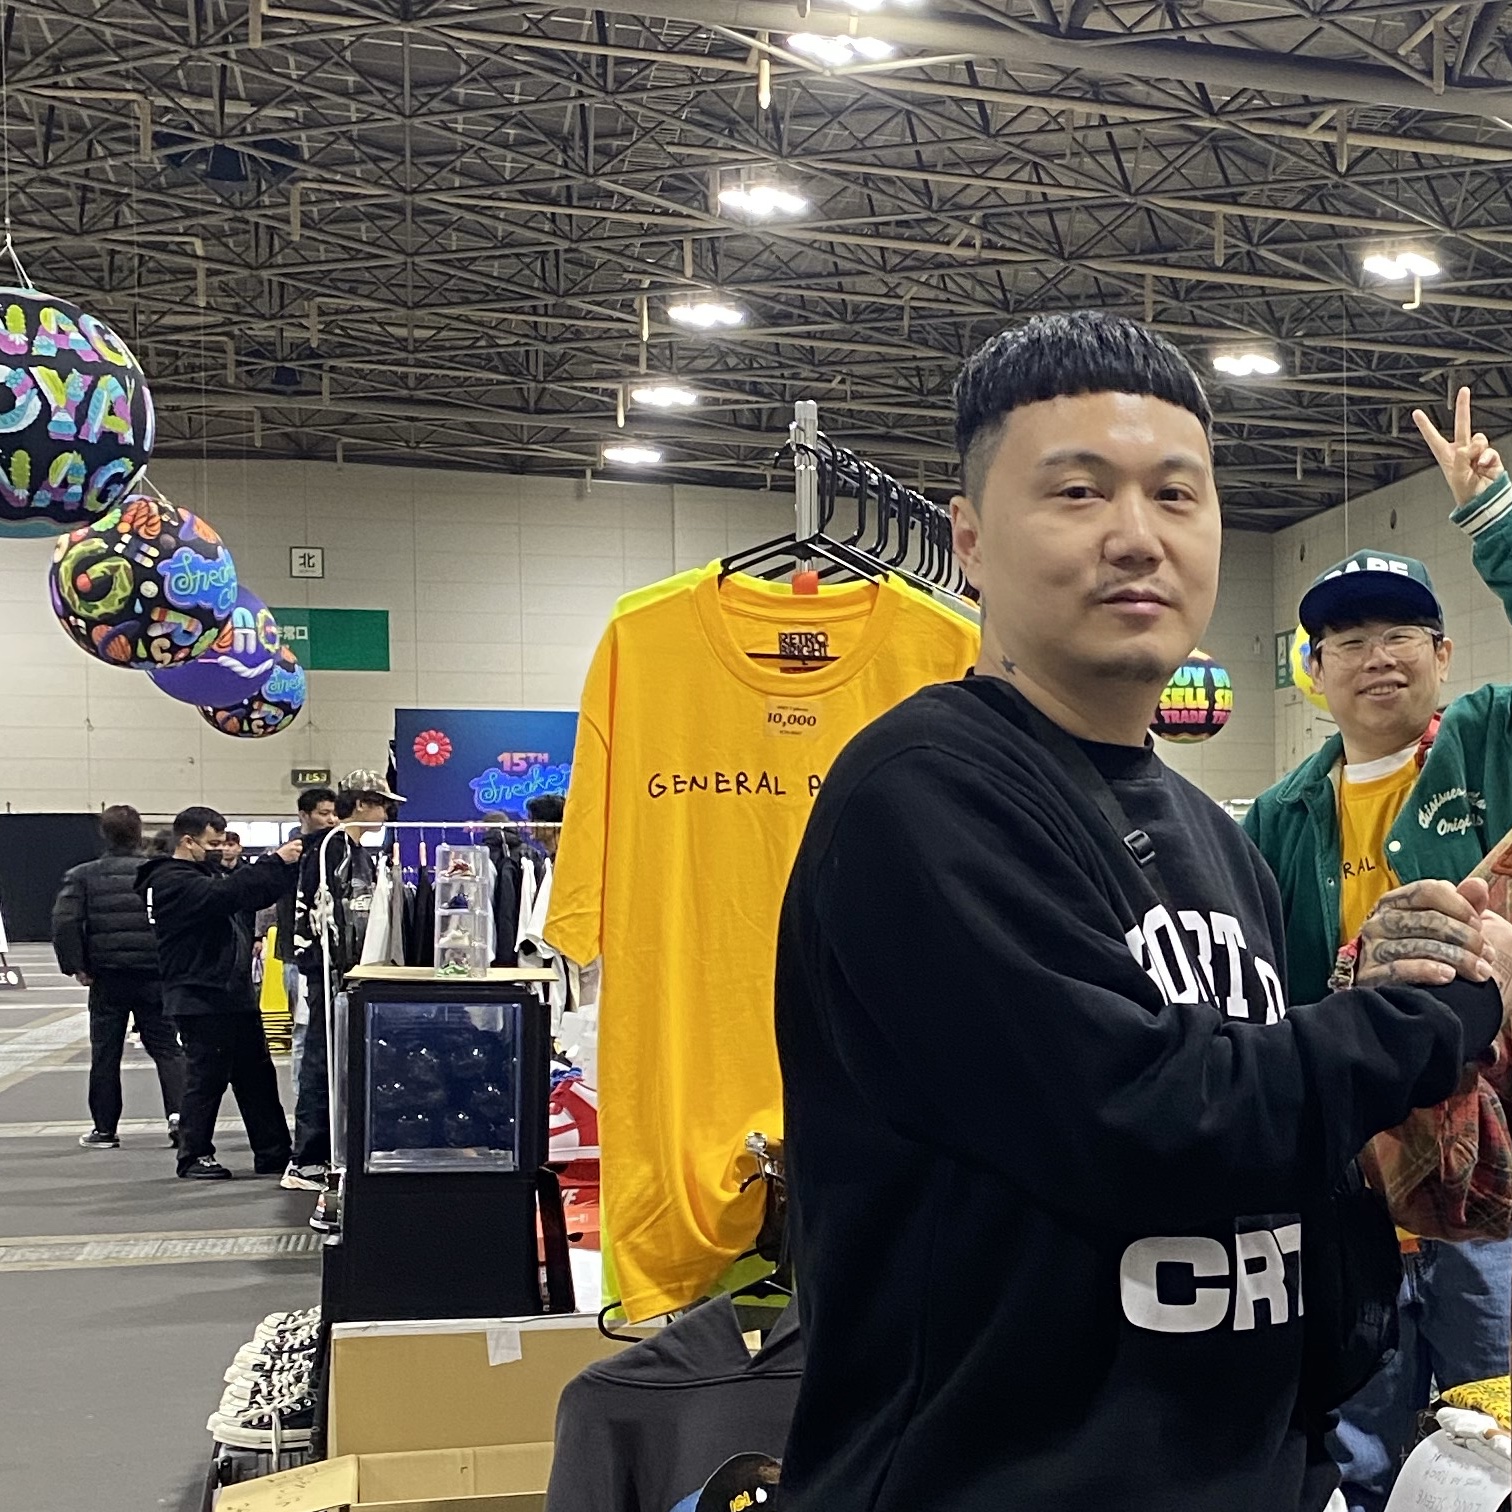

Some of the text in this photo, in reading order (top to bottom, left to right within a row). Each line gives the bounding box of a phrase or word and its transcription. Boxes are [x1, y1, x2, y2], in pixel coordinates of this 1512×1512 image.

[298, 552, 316, 569] 北
[1167, 666, 1205, 687] UY
[1159, 687, 1209, 710] SELL
[767, 712, 817, 728] 10,000
[497, 752, 549, 772] 15TH
[647, 771, 787, 799] GENERAL
